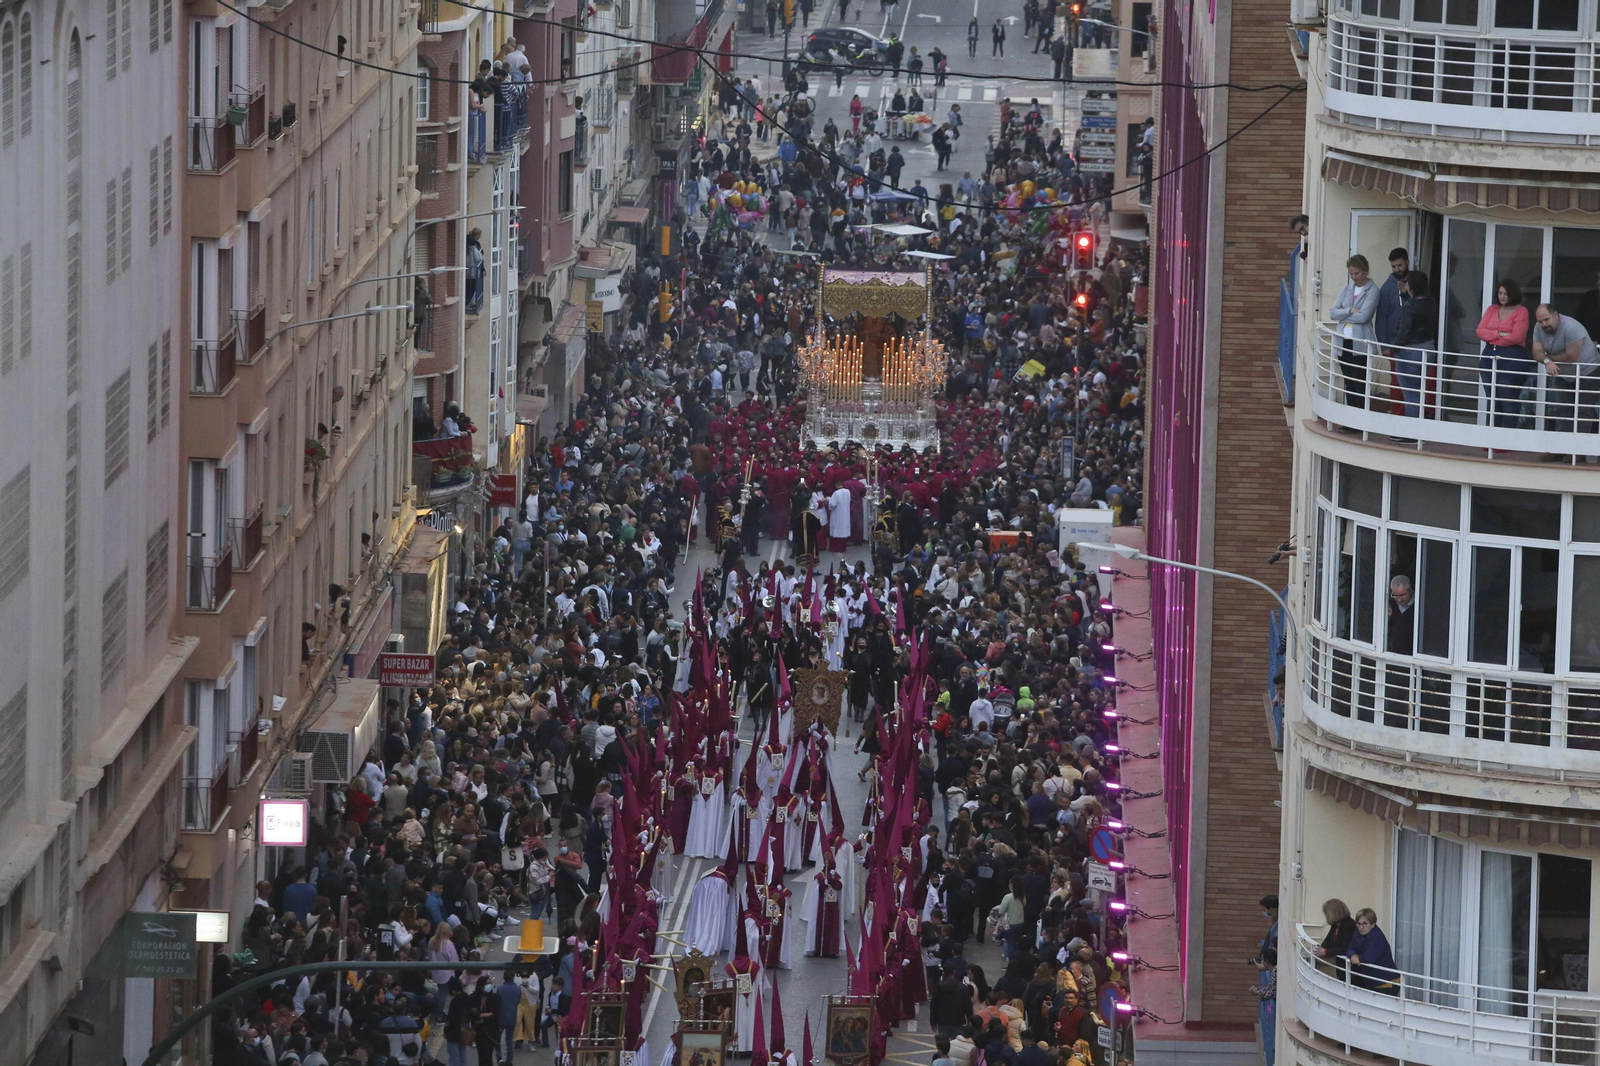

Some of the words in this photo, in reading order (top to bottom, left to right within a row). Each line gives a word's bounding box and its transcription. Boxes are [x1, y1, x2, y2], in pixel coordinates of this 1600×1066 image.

[383, 658, 406, 669] SUPER
[407, 658, 430, 670] BAZAR
[509, 850, 517, 861] S
